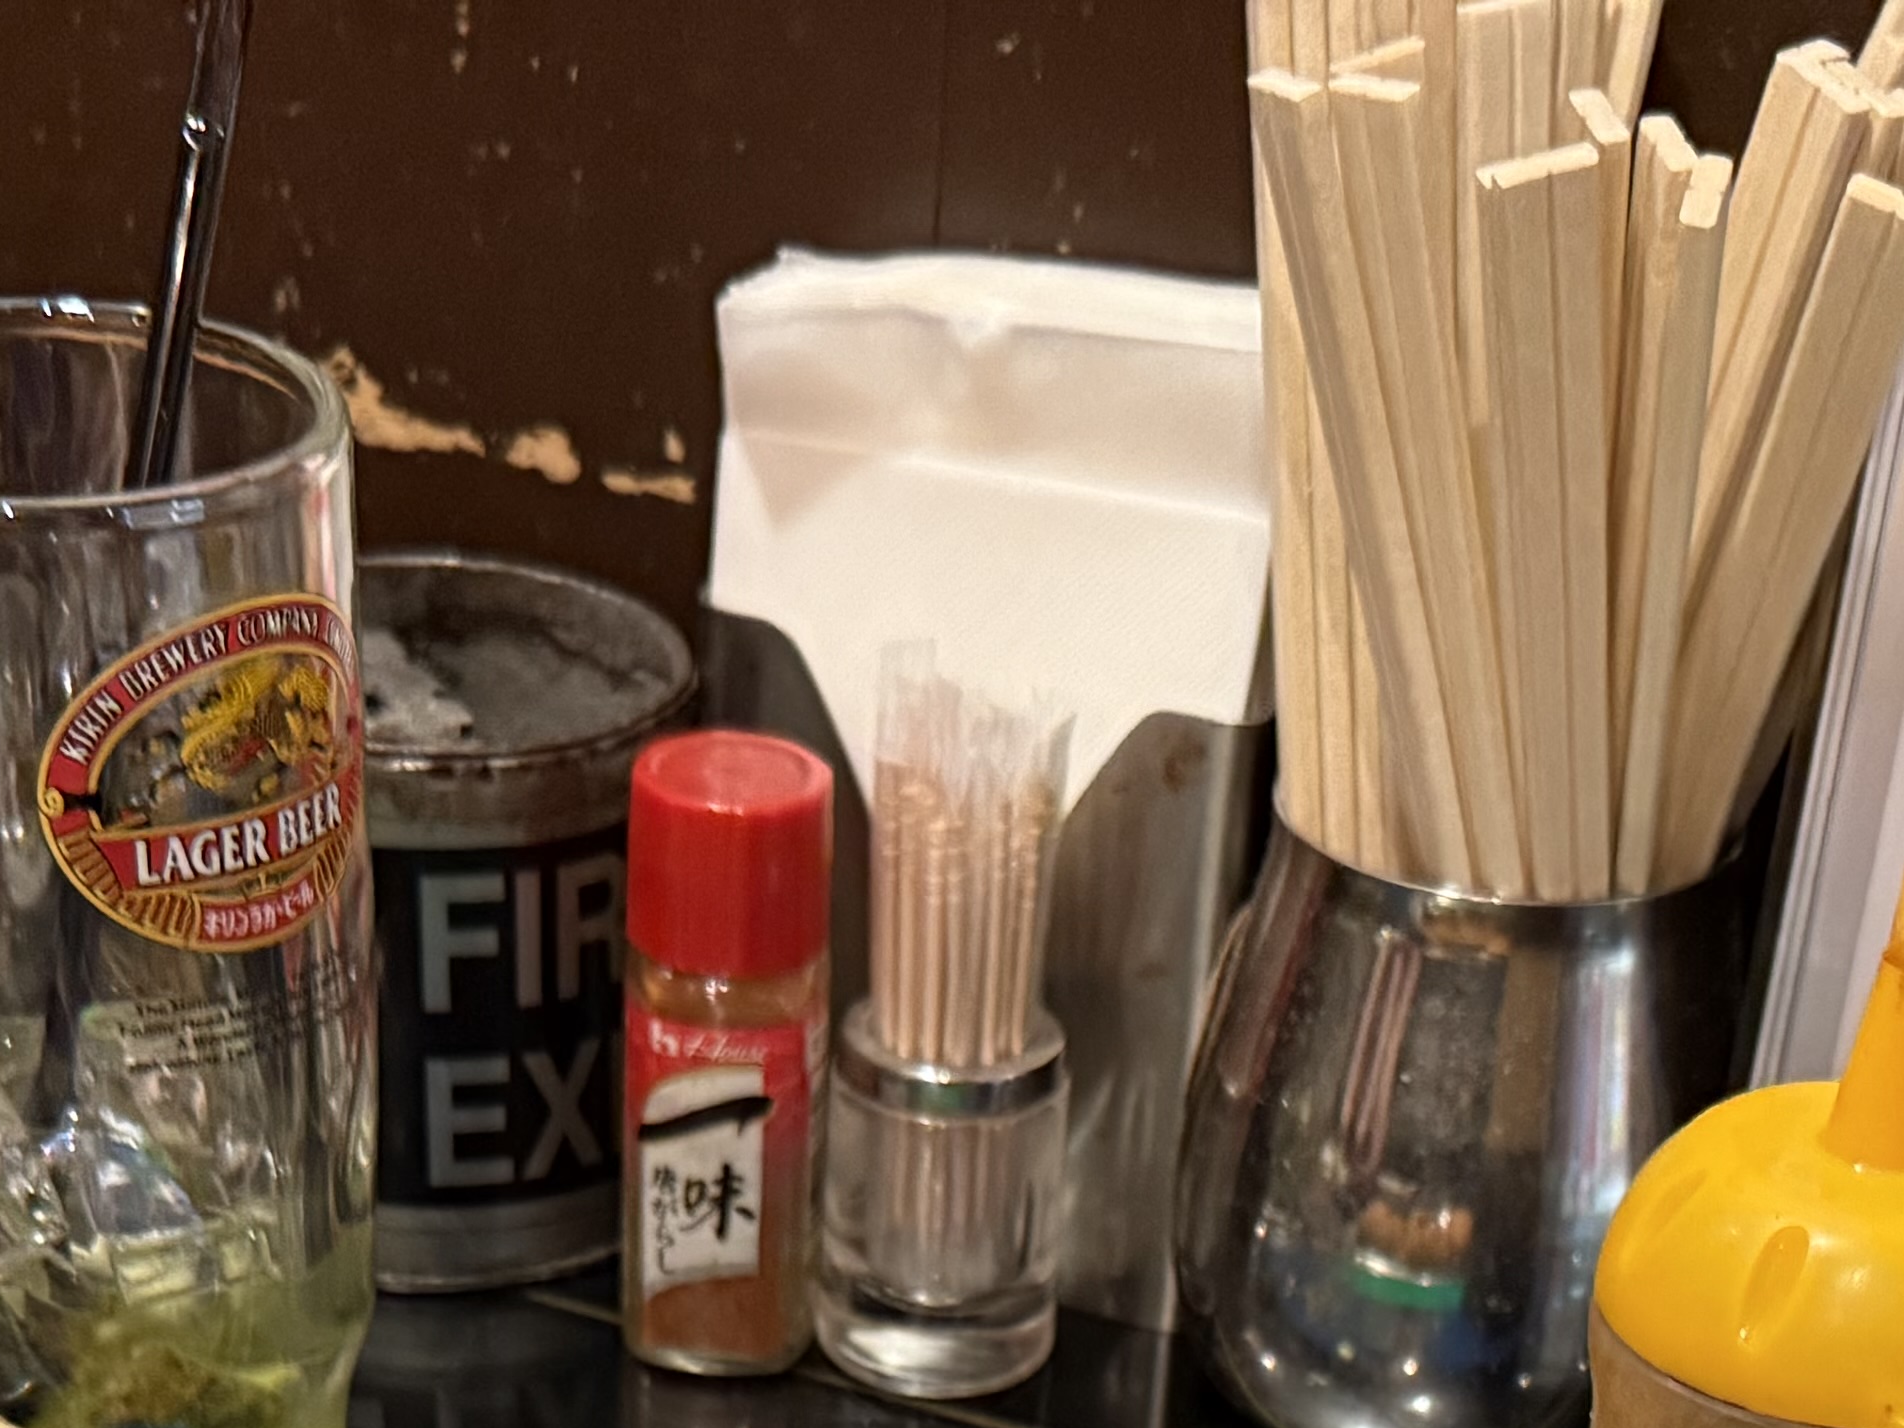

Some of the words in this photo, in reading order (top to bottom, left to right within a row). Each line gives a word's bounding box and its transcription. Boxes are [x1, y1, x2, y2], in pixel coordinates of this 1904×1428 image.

[59, 690, 124, 766] KIRIN
[133, 817, 270, 888] LAGER
[277, 782, 342, 858] BEER
